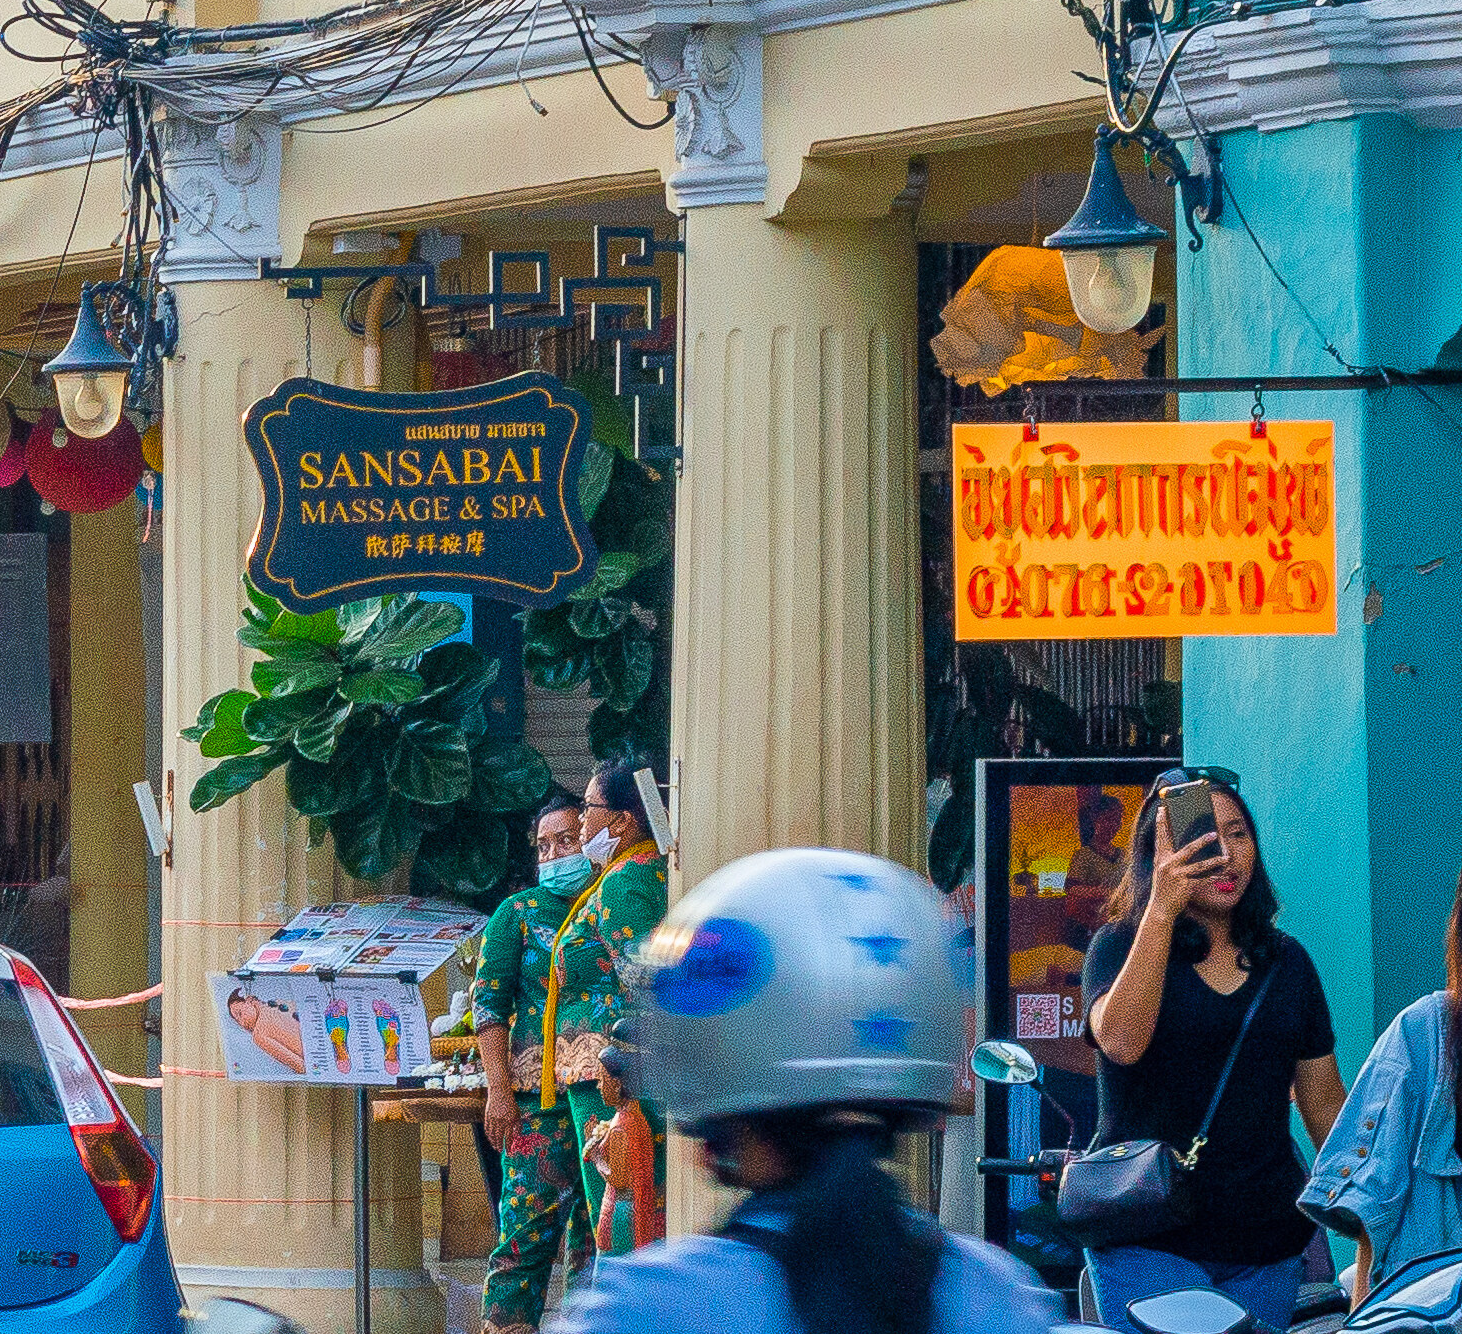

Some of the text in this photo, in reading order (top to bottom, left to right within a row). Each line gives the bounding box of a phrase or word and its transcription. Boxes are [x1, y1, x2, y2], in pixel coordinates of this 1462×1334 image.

[299, 447, 543, 490] SANSABAI
[300, 494, 547, 525] MASSAGE & SPA
